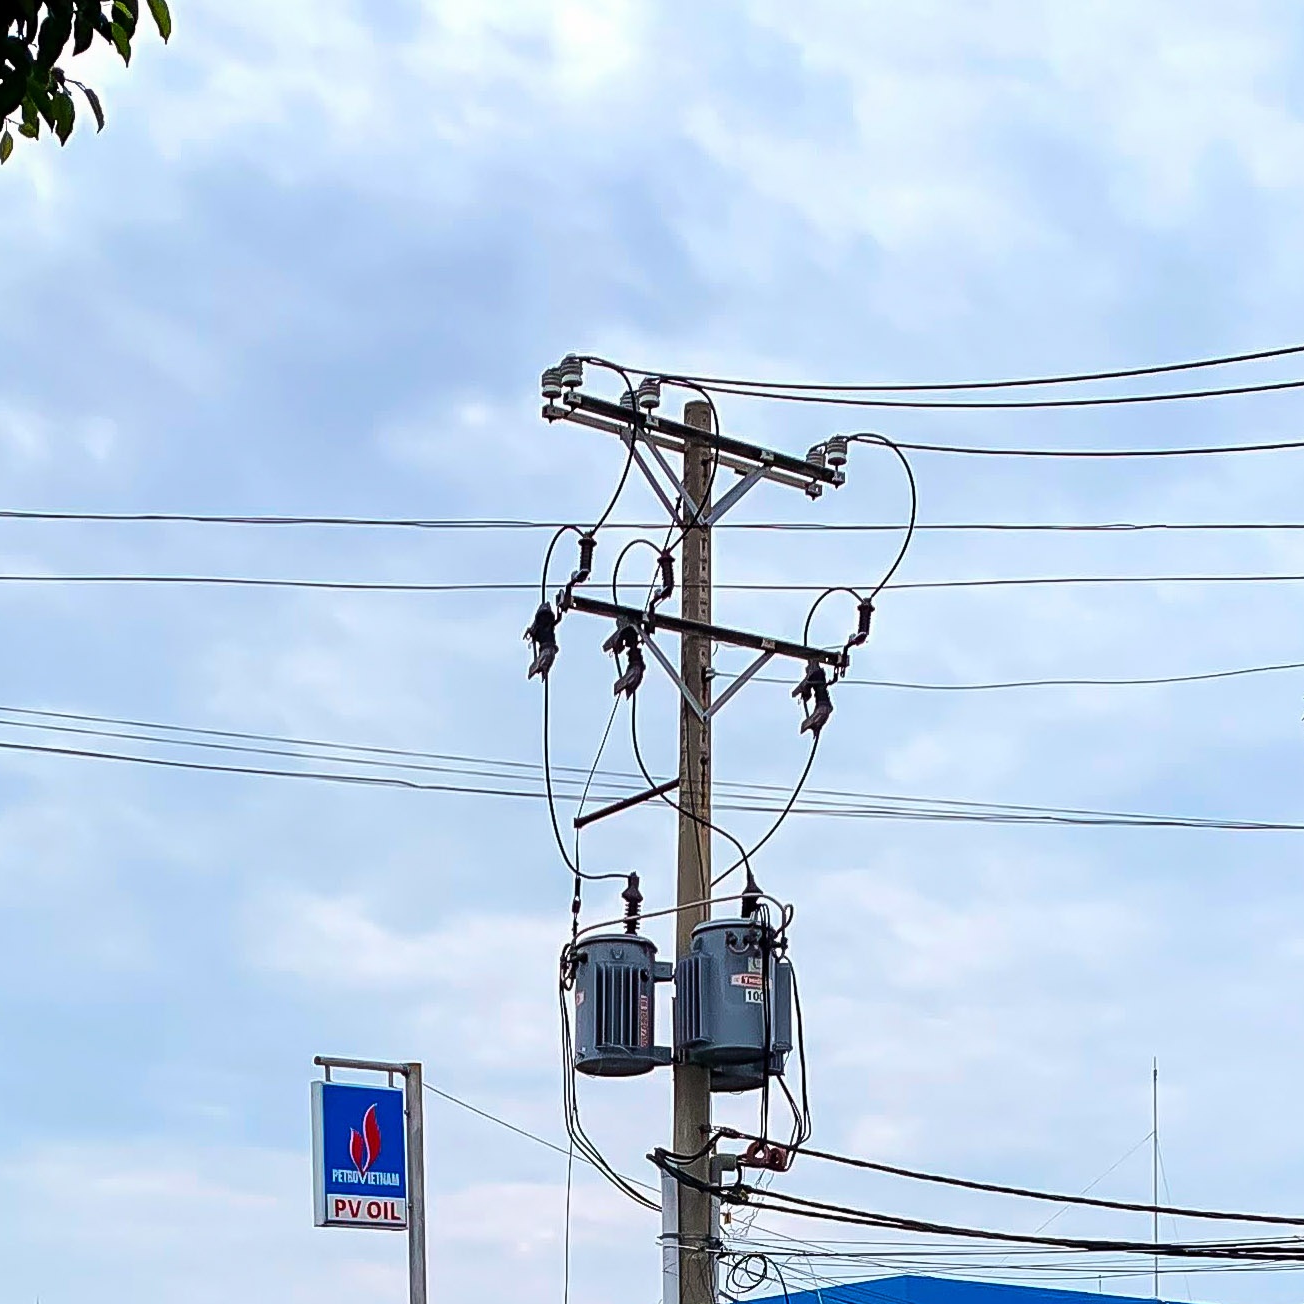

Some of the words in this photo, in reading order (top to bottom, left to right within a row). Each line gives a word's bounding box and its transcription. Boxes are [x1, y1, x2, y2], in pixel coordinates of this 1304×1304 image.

[332, 1168, 401, 1187] PETROVIETNAM
[335, 1198, 362, 1219] PV
[366, 1201, 401, 1221] OIL
